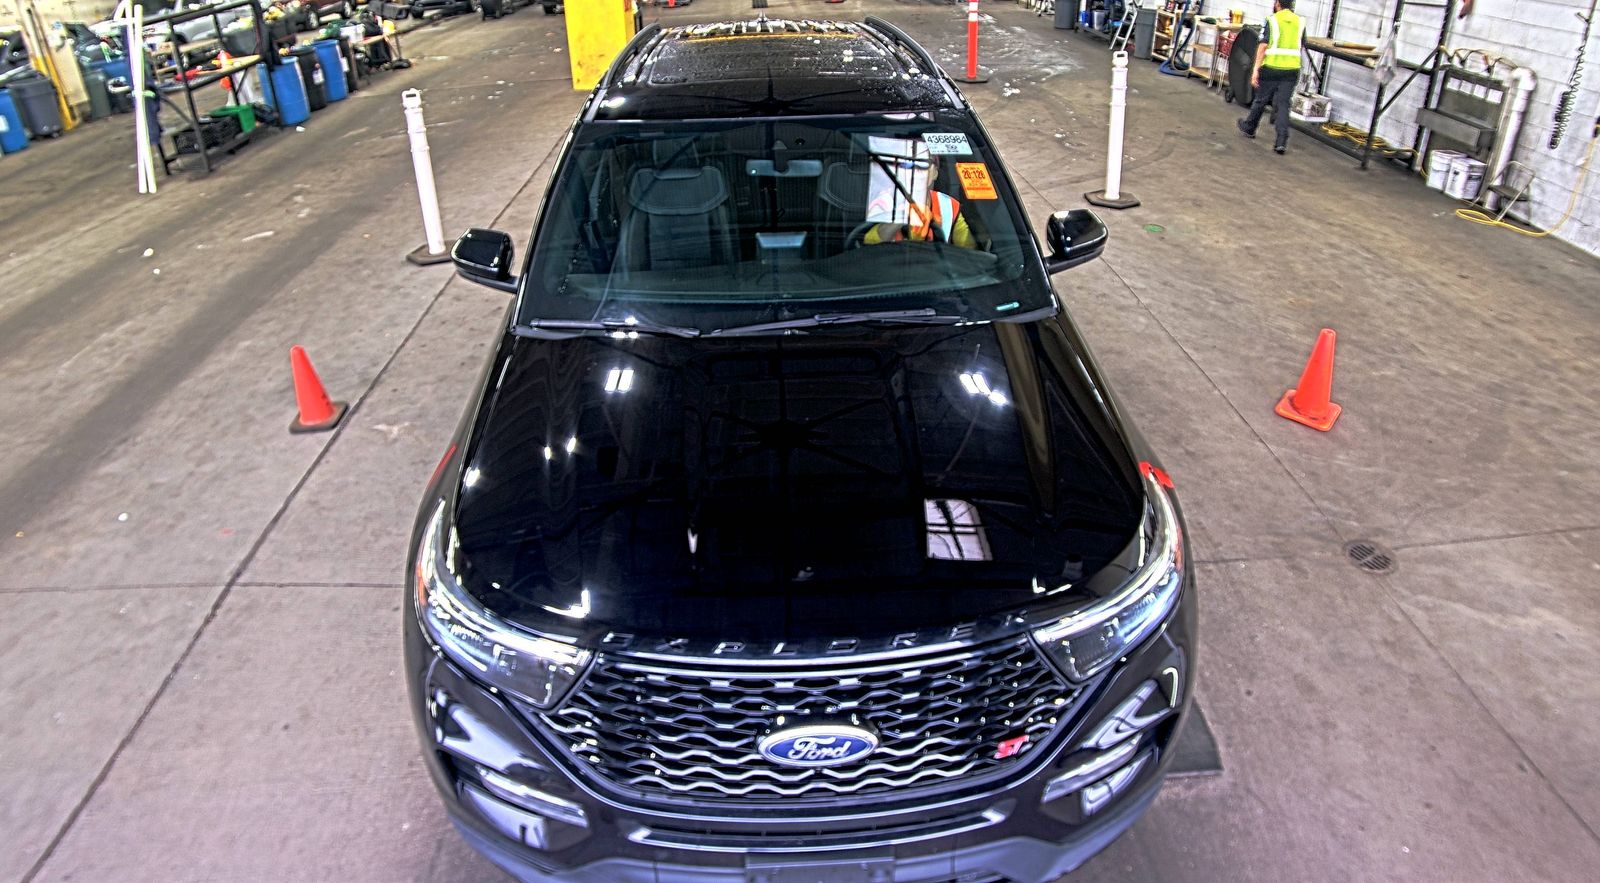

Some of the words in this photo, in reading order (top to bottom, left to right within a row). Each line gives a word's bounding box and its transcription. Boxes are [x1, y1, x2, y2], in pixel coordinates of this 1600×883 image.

[927, 135, 968, 144] 4368984
[787, 736, 852, 760] Ford
[994, 735, 1030, 760] ST
